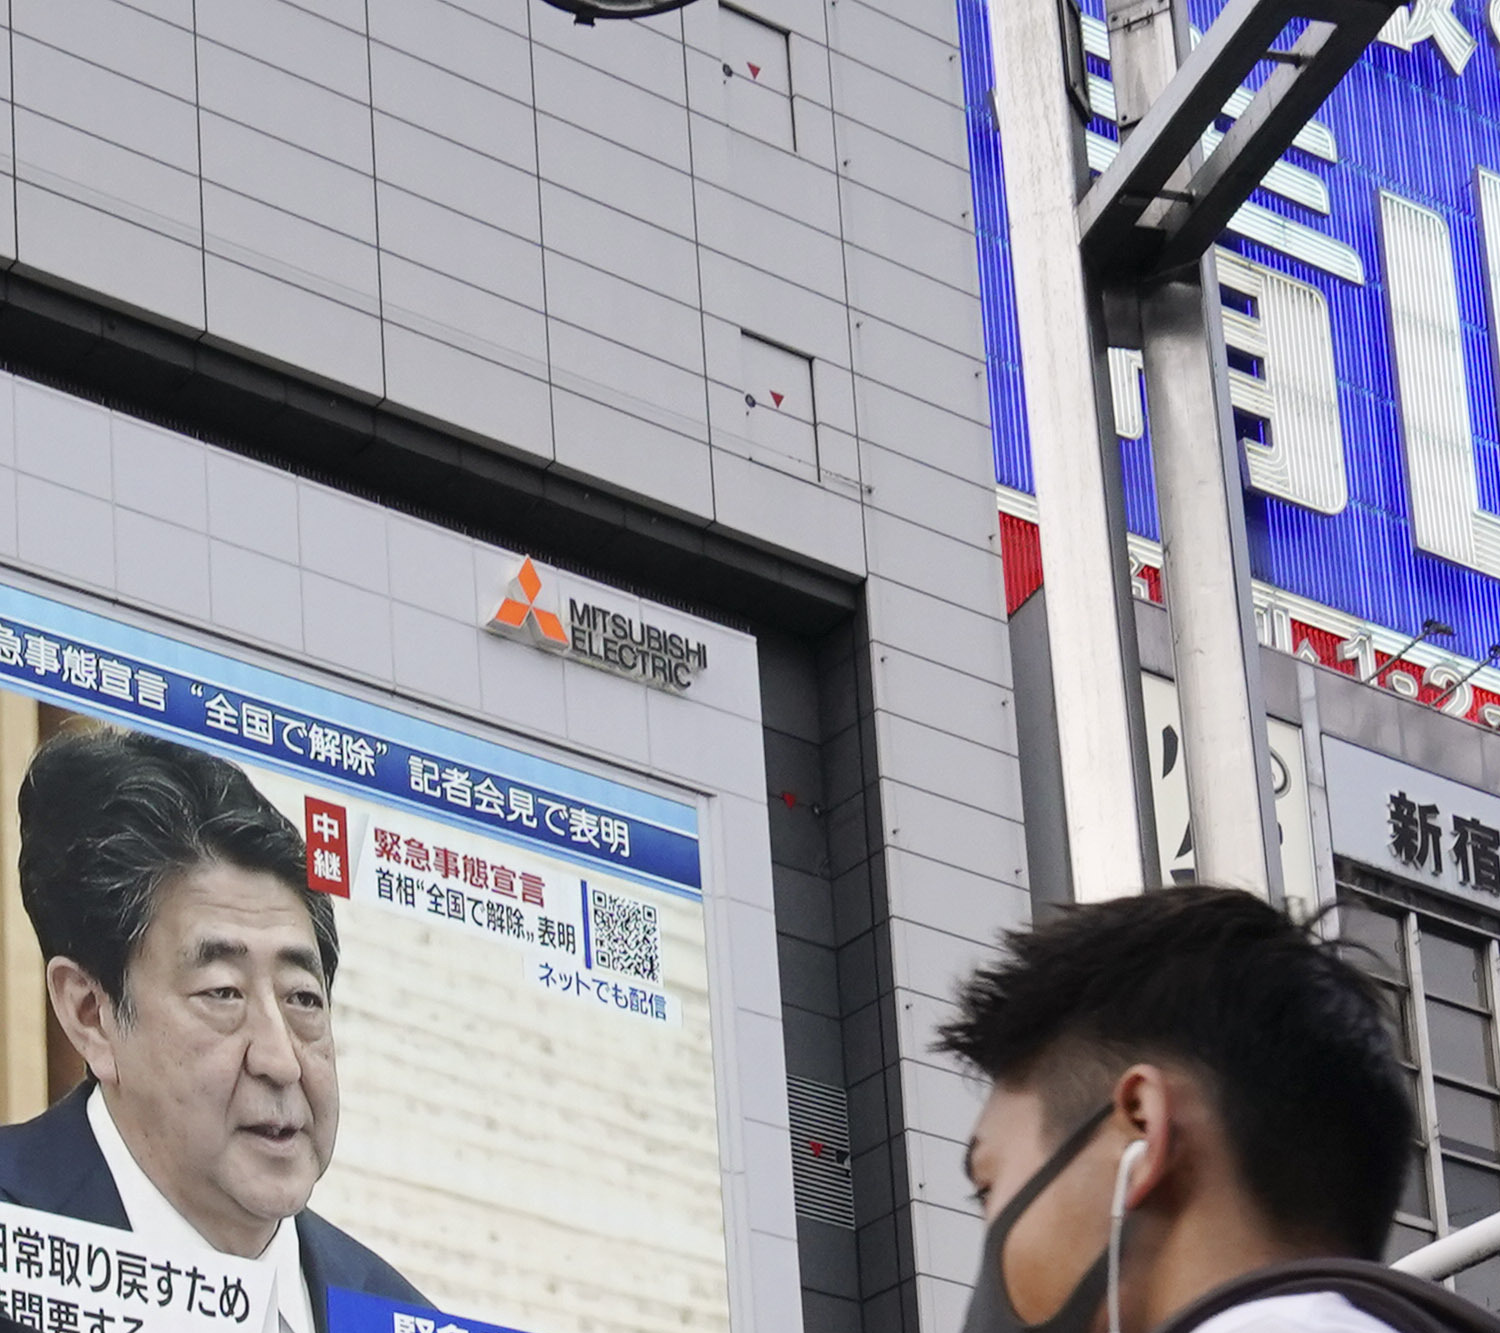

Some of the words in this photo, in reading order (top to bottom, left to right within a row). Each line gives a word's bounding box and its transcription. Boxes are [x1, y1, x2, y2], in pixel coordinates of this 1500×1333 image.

[568, 597, 708, 671] MITSUBISHI
[570, 626, 693, 692] ELECTRIC
[407, 755, 631, 858] 記者会見で表明
[312, 812, 343, 884] 中継
[374, 828, 546, 908] 緊急事態宣言
[539, 962, 667, 1021] ネットでも配信
